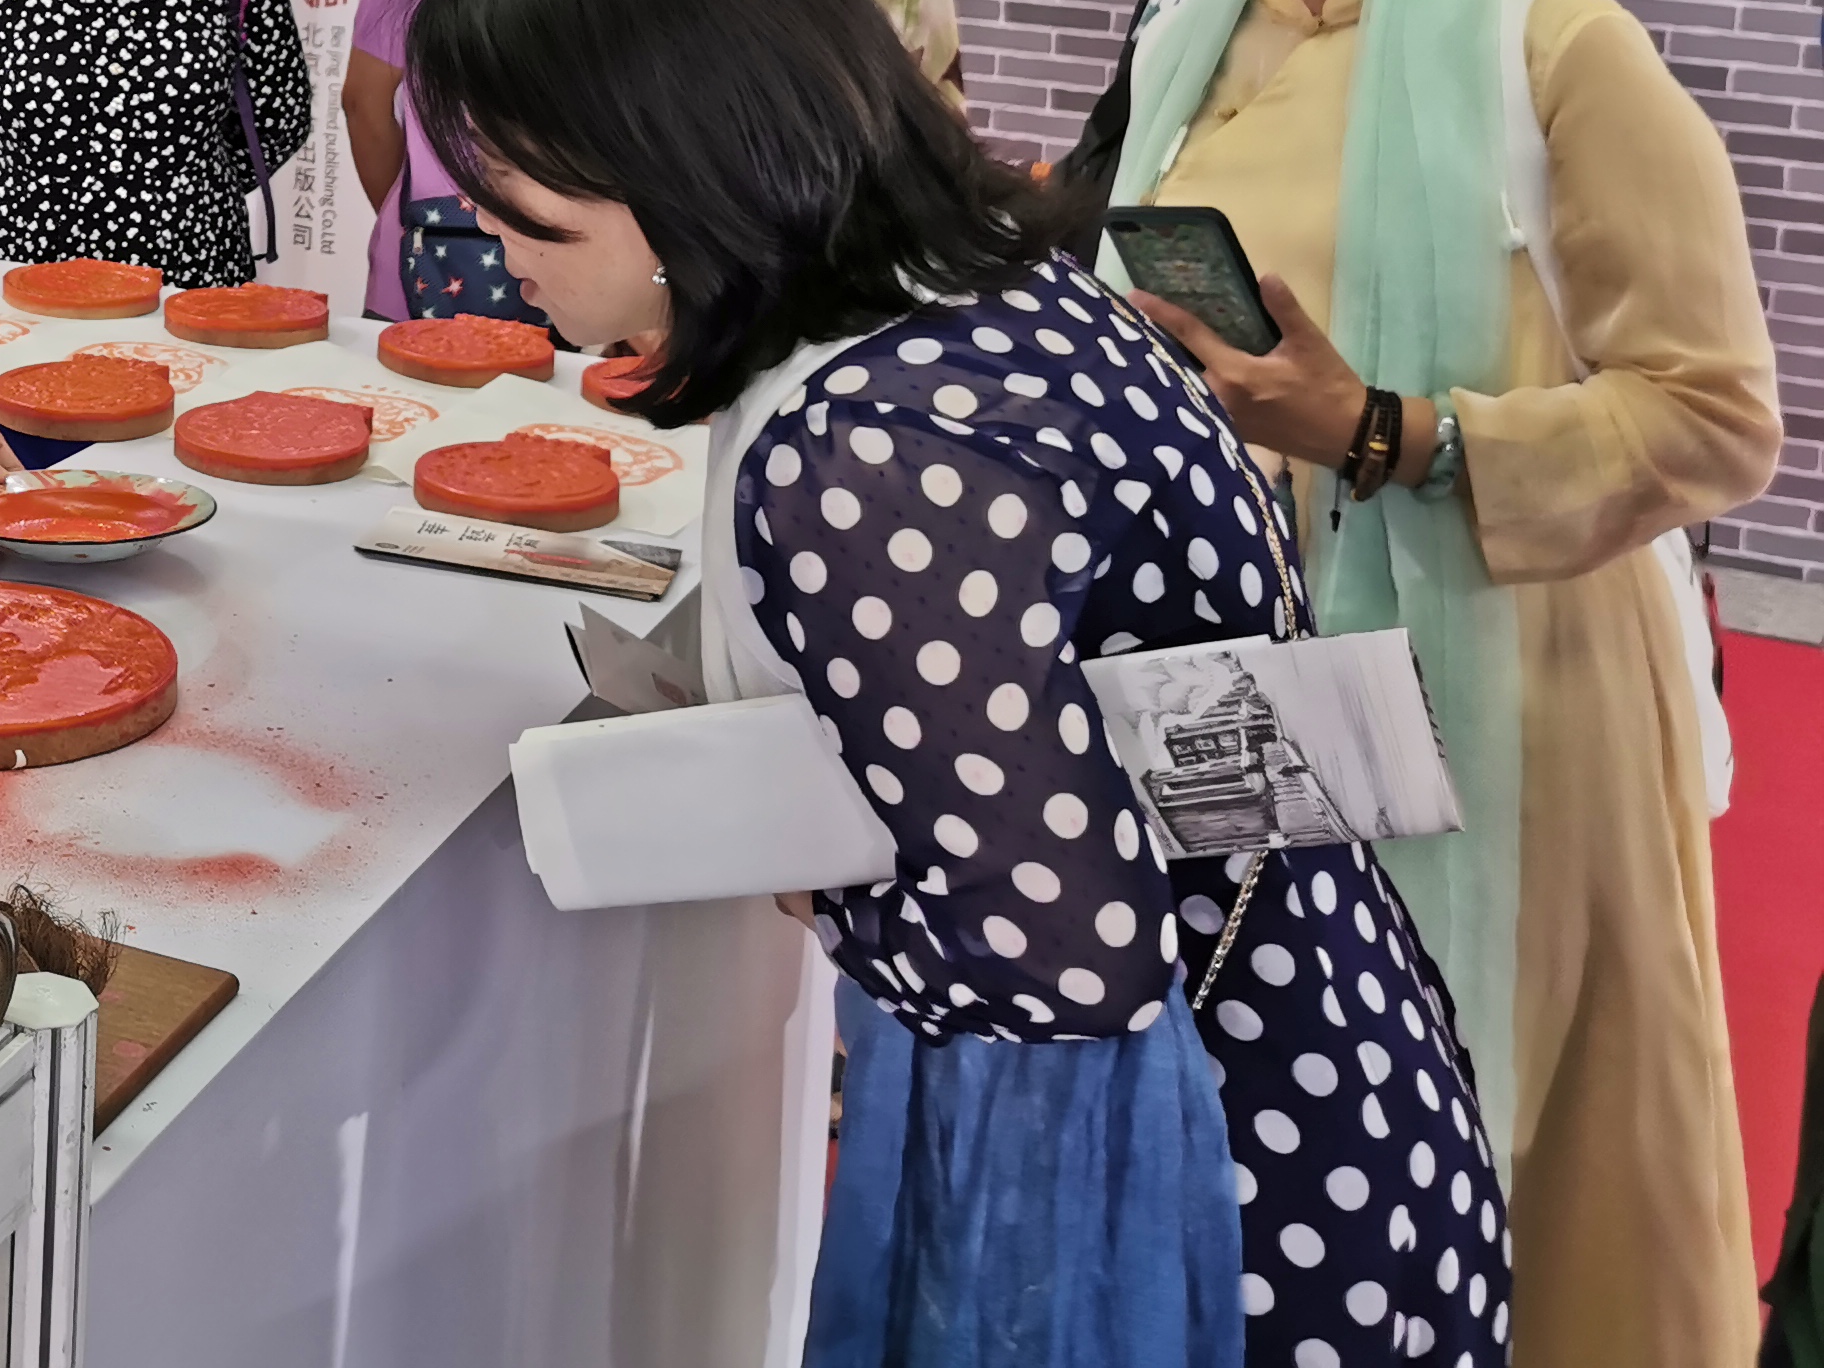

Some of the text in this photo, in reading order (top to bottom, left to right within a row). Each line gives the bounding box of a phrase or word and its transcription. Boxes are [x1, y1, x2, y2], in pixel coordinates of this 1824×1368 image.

[292, 22, 325, 251] 北京出版公司
